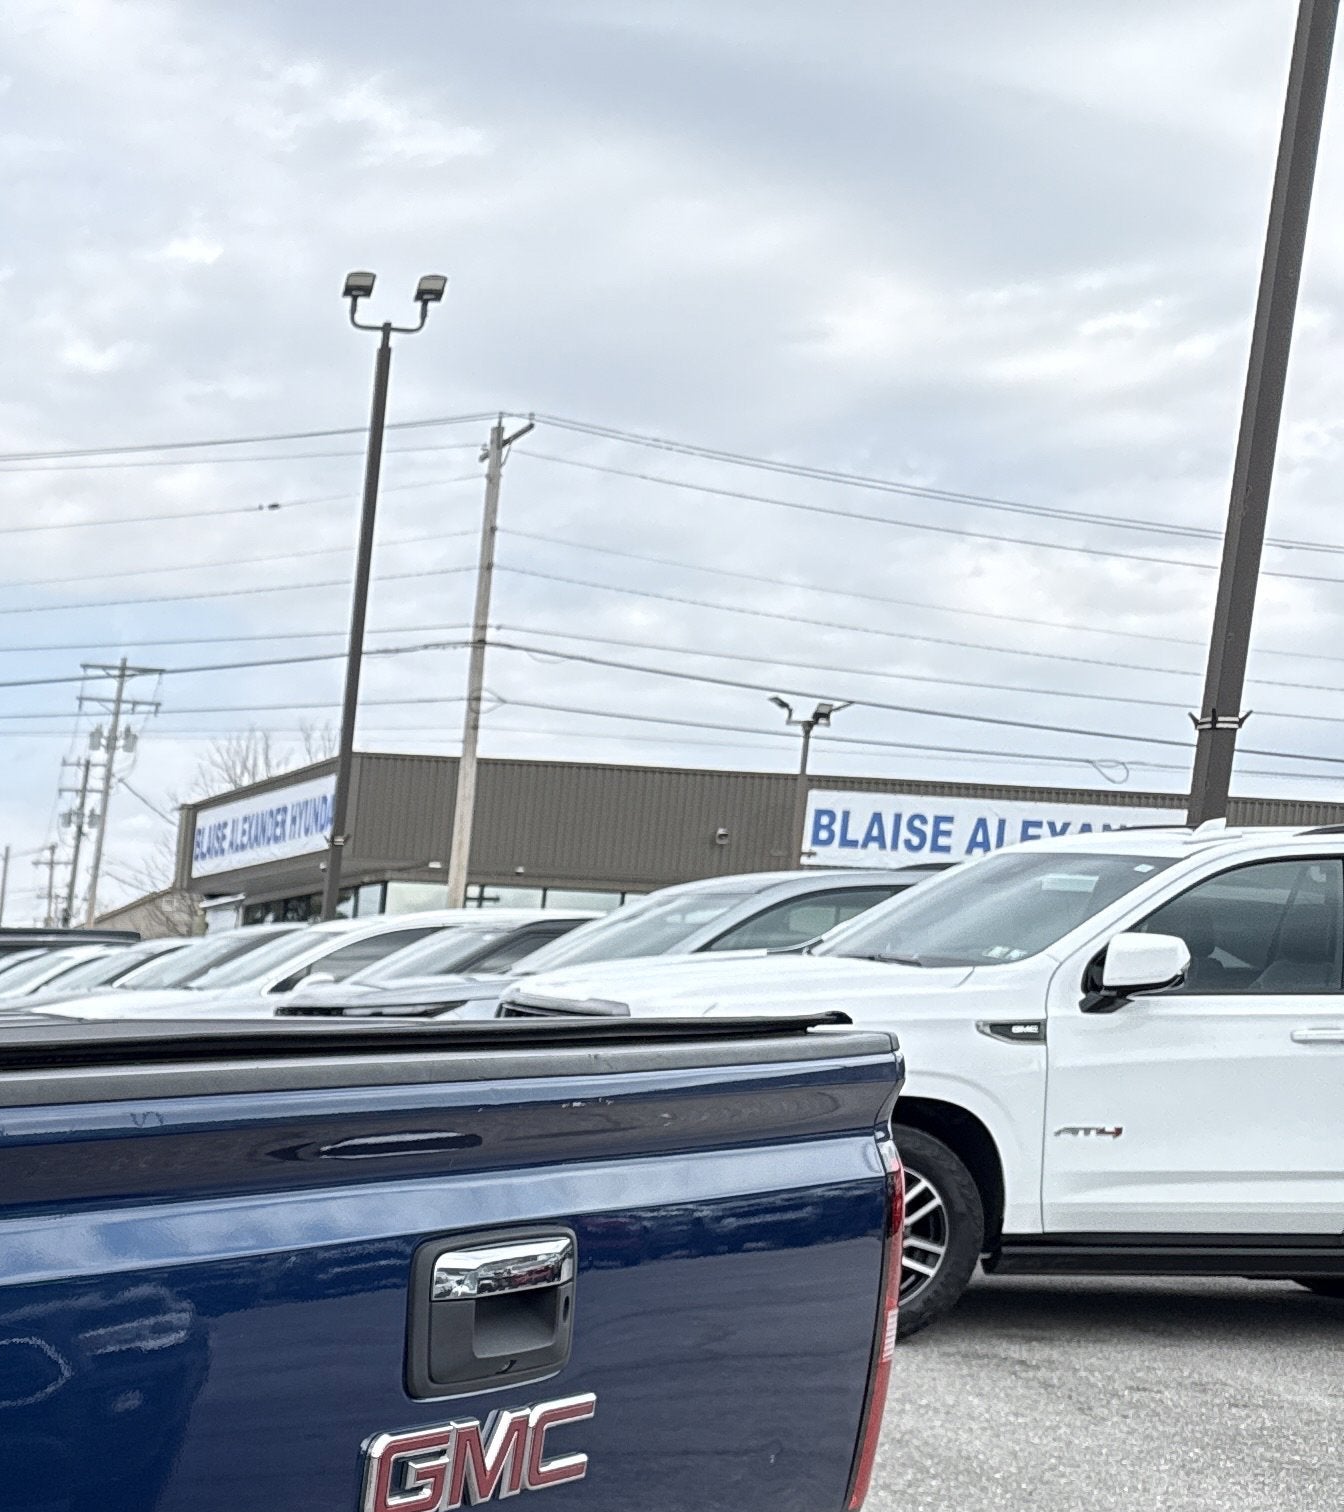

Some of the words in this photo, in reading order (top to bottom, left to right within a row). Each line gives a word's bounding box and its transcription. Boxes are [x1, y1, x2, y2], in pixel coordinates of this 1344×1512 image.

[194, 820, 228, 862] BLAISE
[228, 805, 289, 852] ALEXANDER
[288, 794, 336, 841] HYUNDA
[812, 808, 954, 854] BLAISE
[965, 817, 1127, 856] ALE
[1054, 1126, 1123, 1139] AT4
